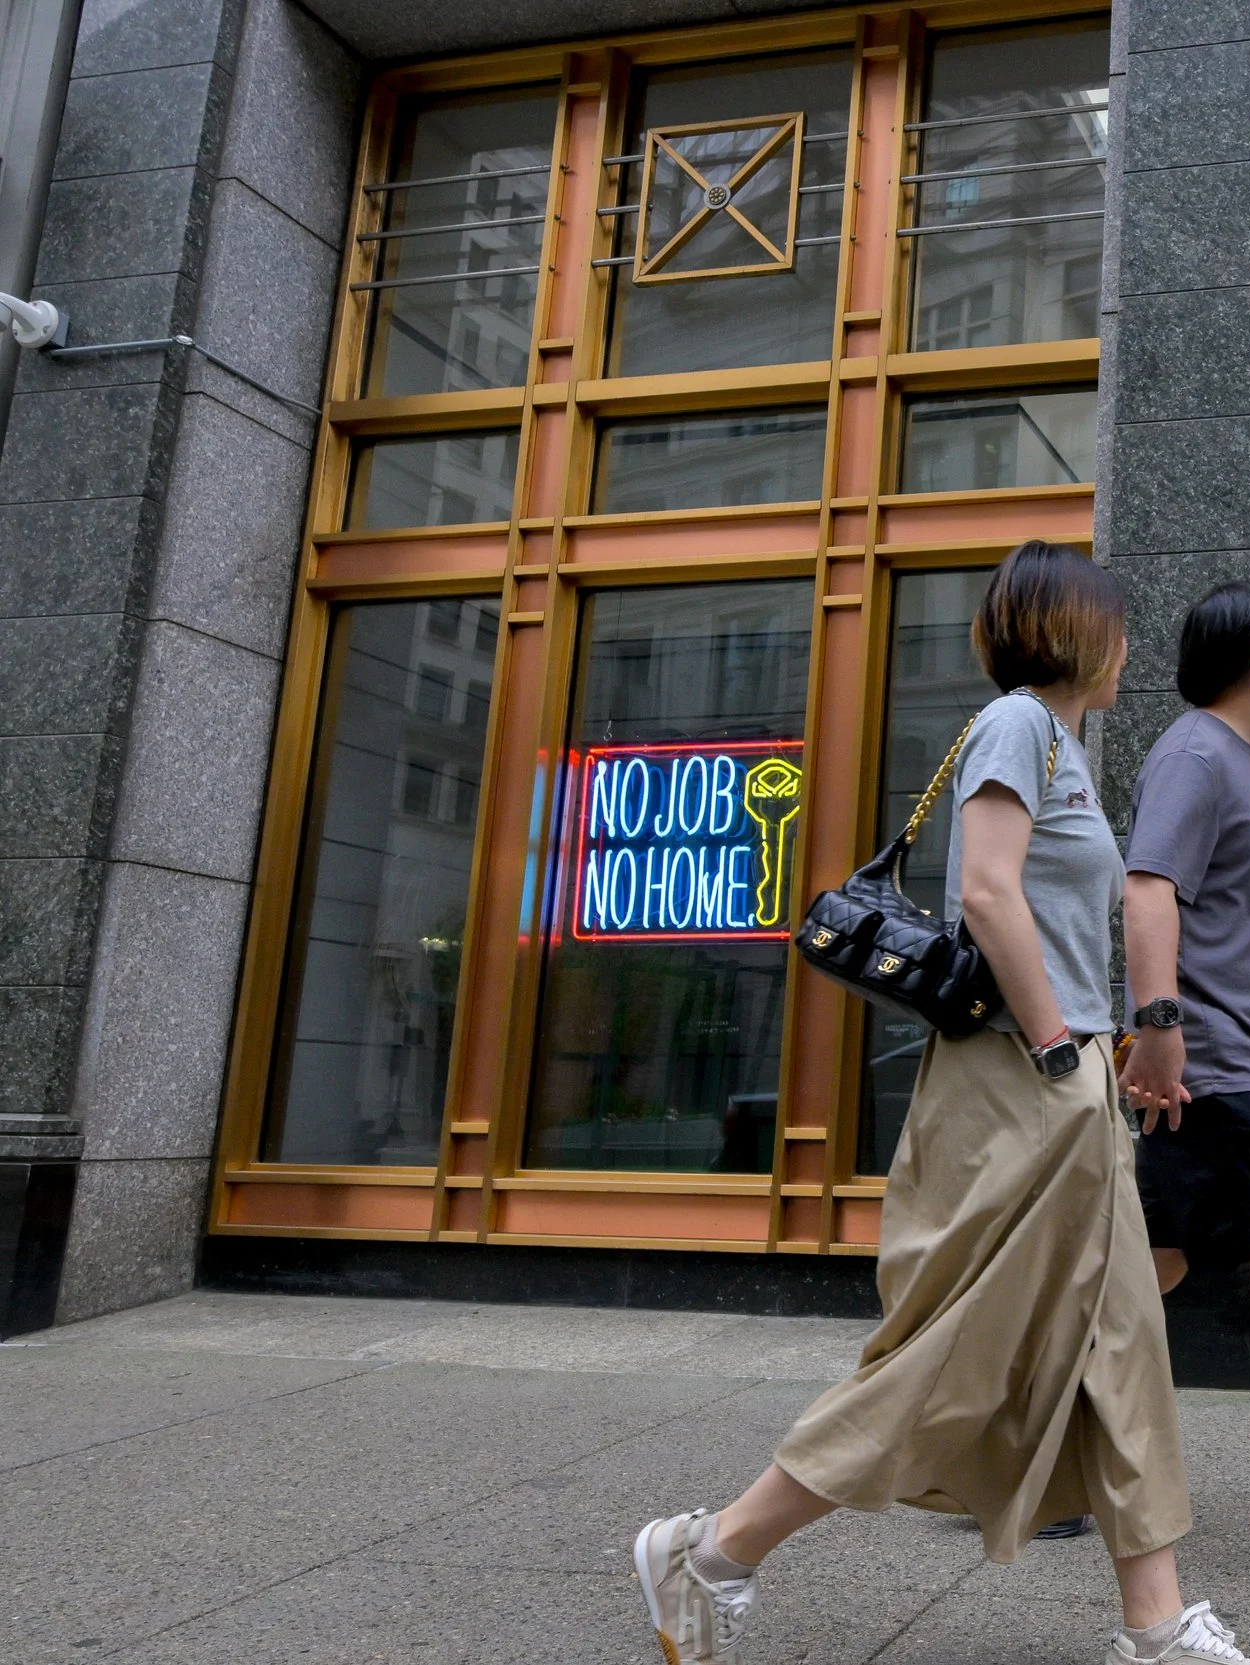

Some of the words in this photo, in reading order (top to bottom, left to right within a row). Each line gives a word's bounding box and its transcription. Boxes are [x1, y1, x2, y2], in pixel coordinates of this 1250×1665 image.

[589, 757, 650, 838] NO
[654, 754, 736, 837] JOB
[583, 847, 637, 930] NO
